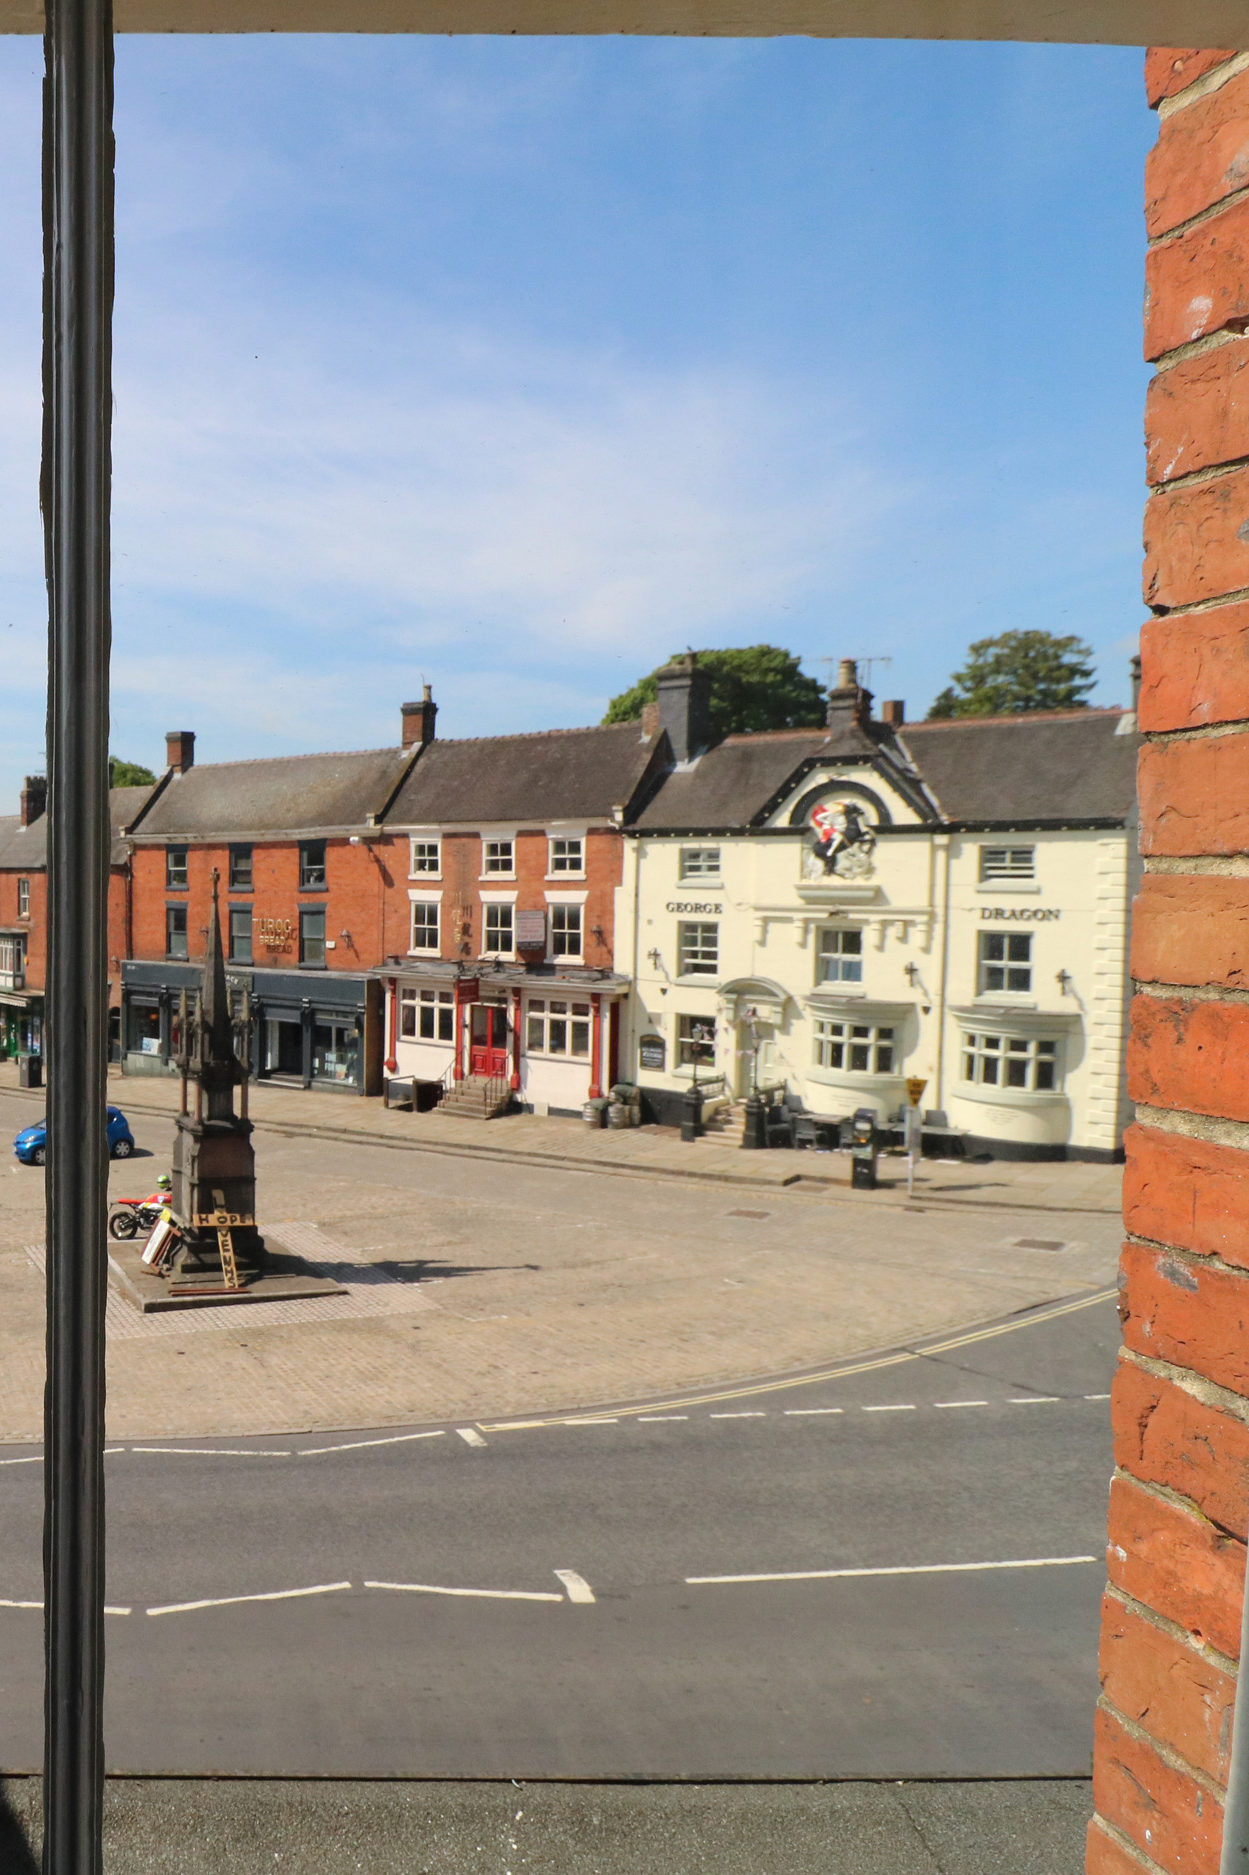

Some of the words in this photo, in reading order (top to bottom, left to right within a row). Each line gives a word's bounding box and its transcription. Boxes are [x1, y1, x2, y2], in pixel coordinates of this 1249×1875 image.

[666, 902, 723, 914] GEORGE
[980, 907, 1061, 921] DRAGON
[259, 935, 286, 946] BREAD
[198, 1214, 247, 1226] HOPE
